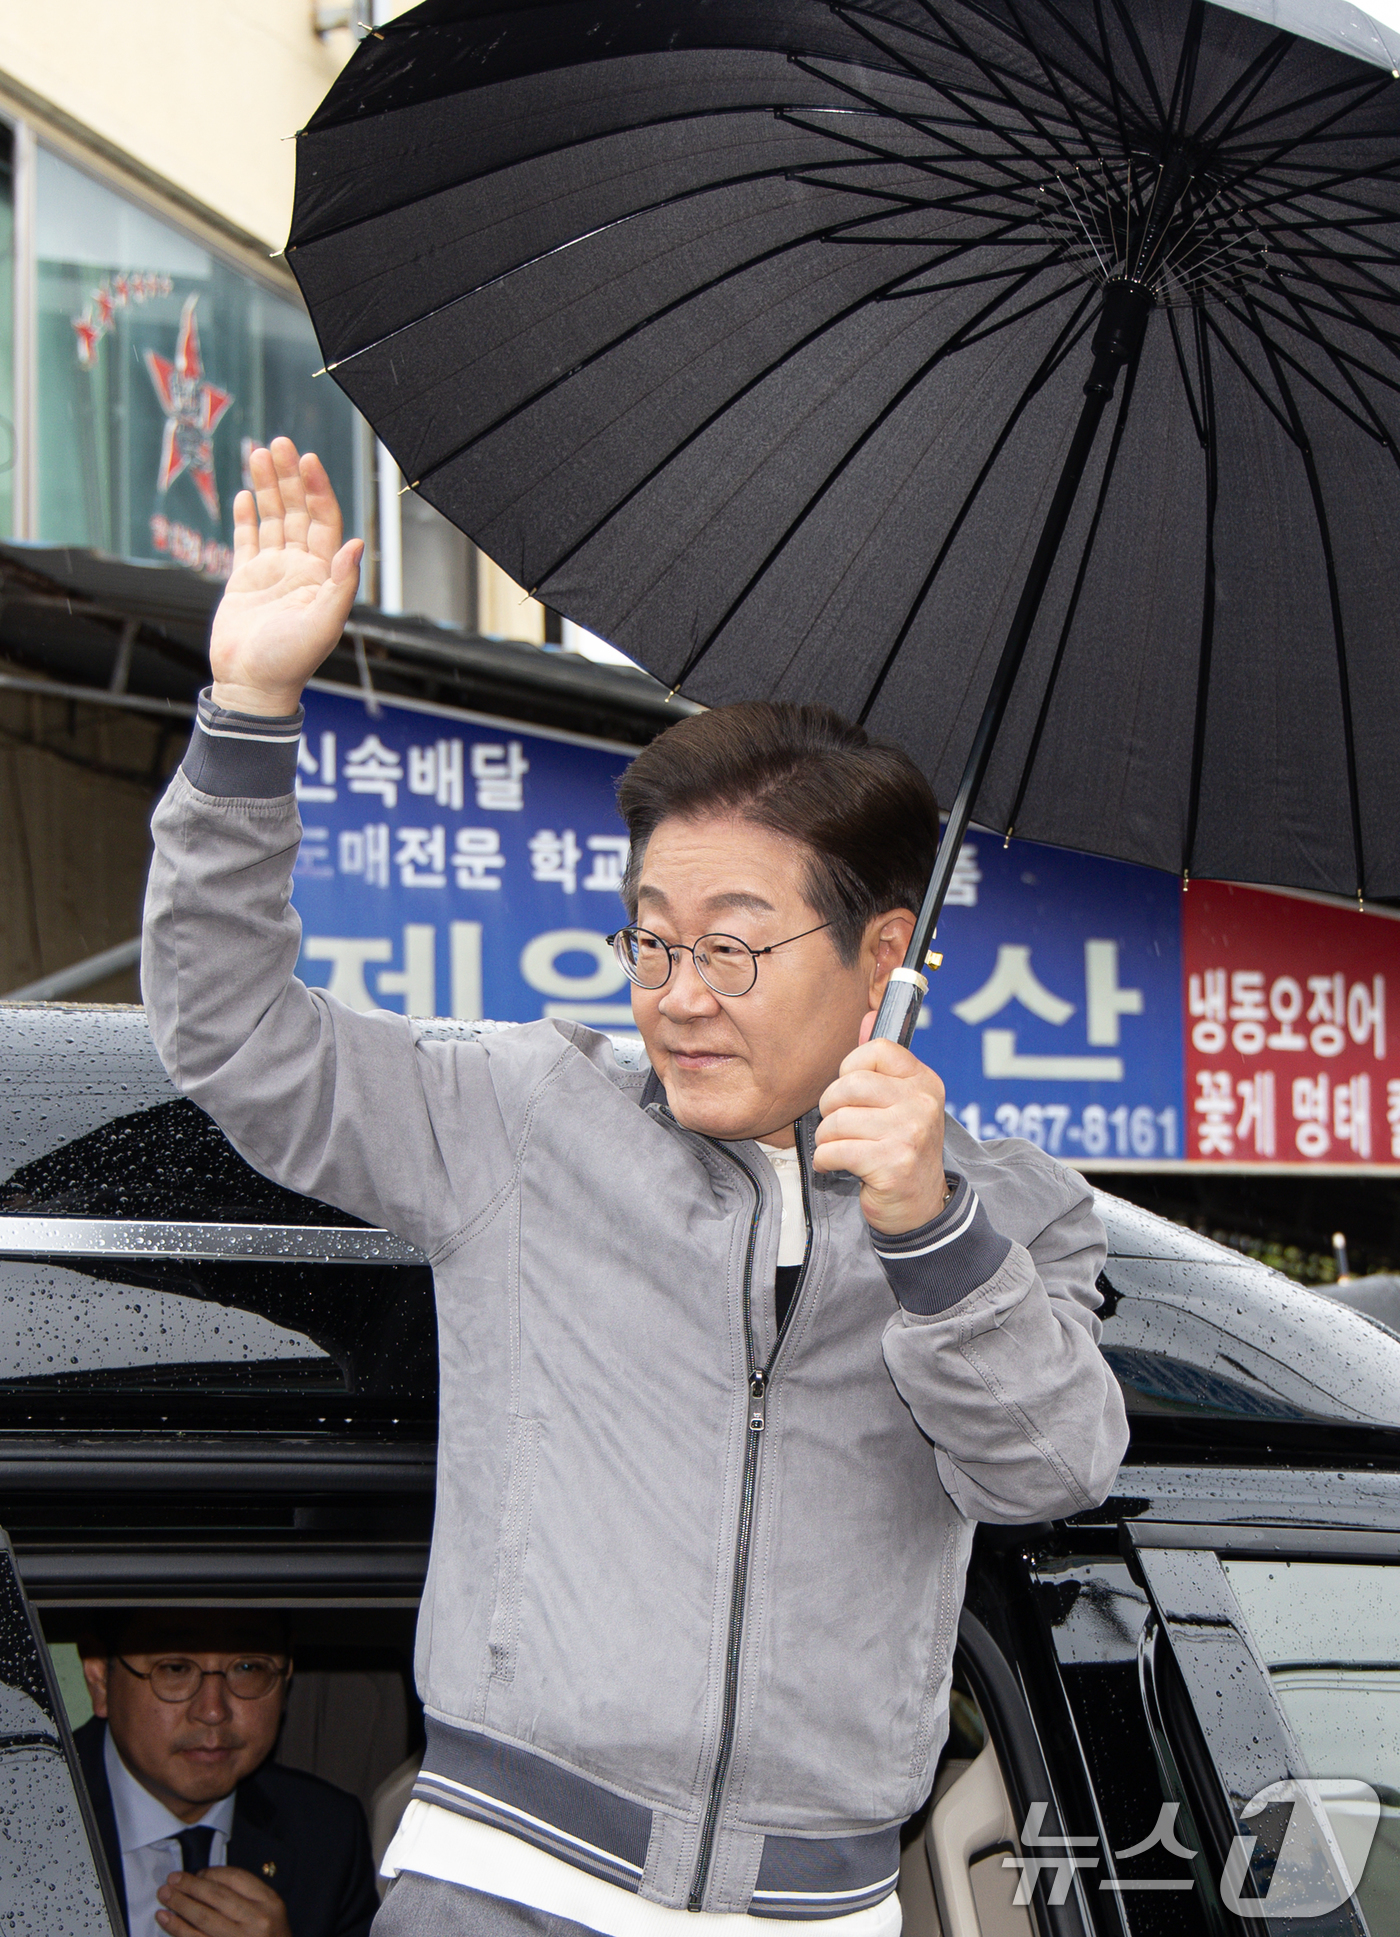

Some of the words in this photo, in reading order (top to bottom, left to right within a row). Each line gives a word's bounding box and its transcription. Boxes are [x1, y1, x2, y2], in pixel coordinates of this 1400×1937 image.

[296, 731, 529, 811] 신속배달
[529, 829, 631, 894] 학교
[1188, 967, 1386, 1060] 냉동오징어
[945, 1102, 1176, 1156] 1-367-8161
[1194, 1070, 1276, 1158] 꽃게
[1292, 1071, 1372, 1159] 명태
